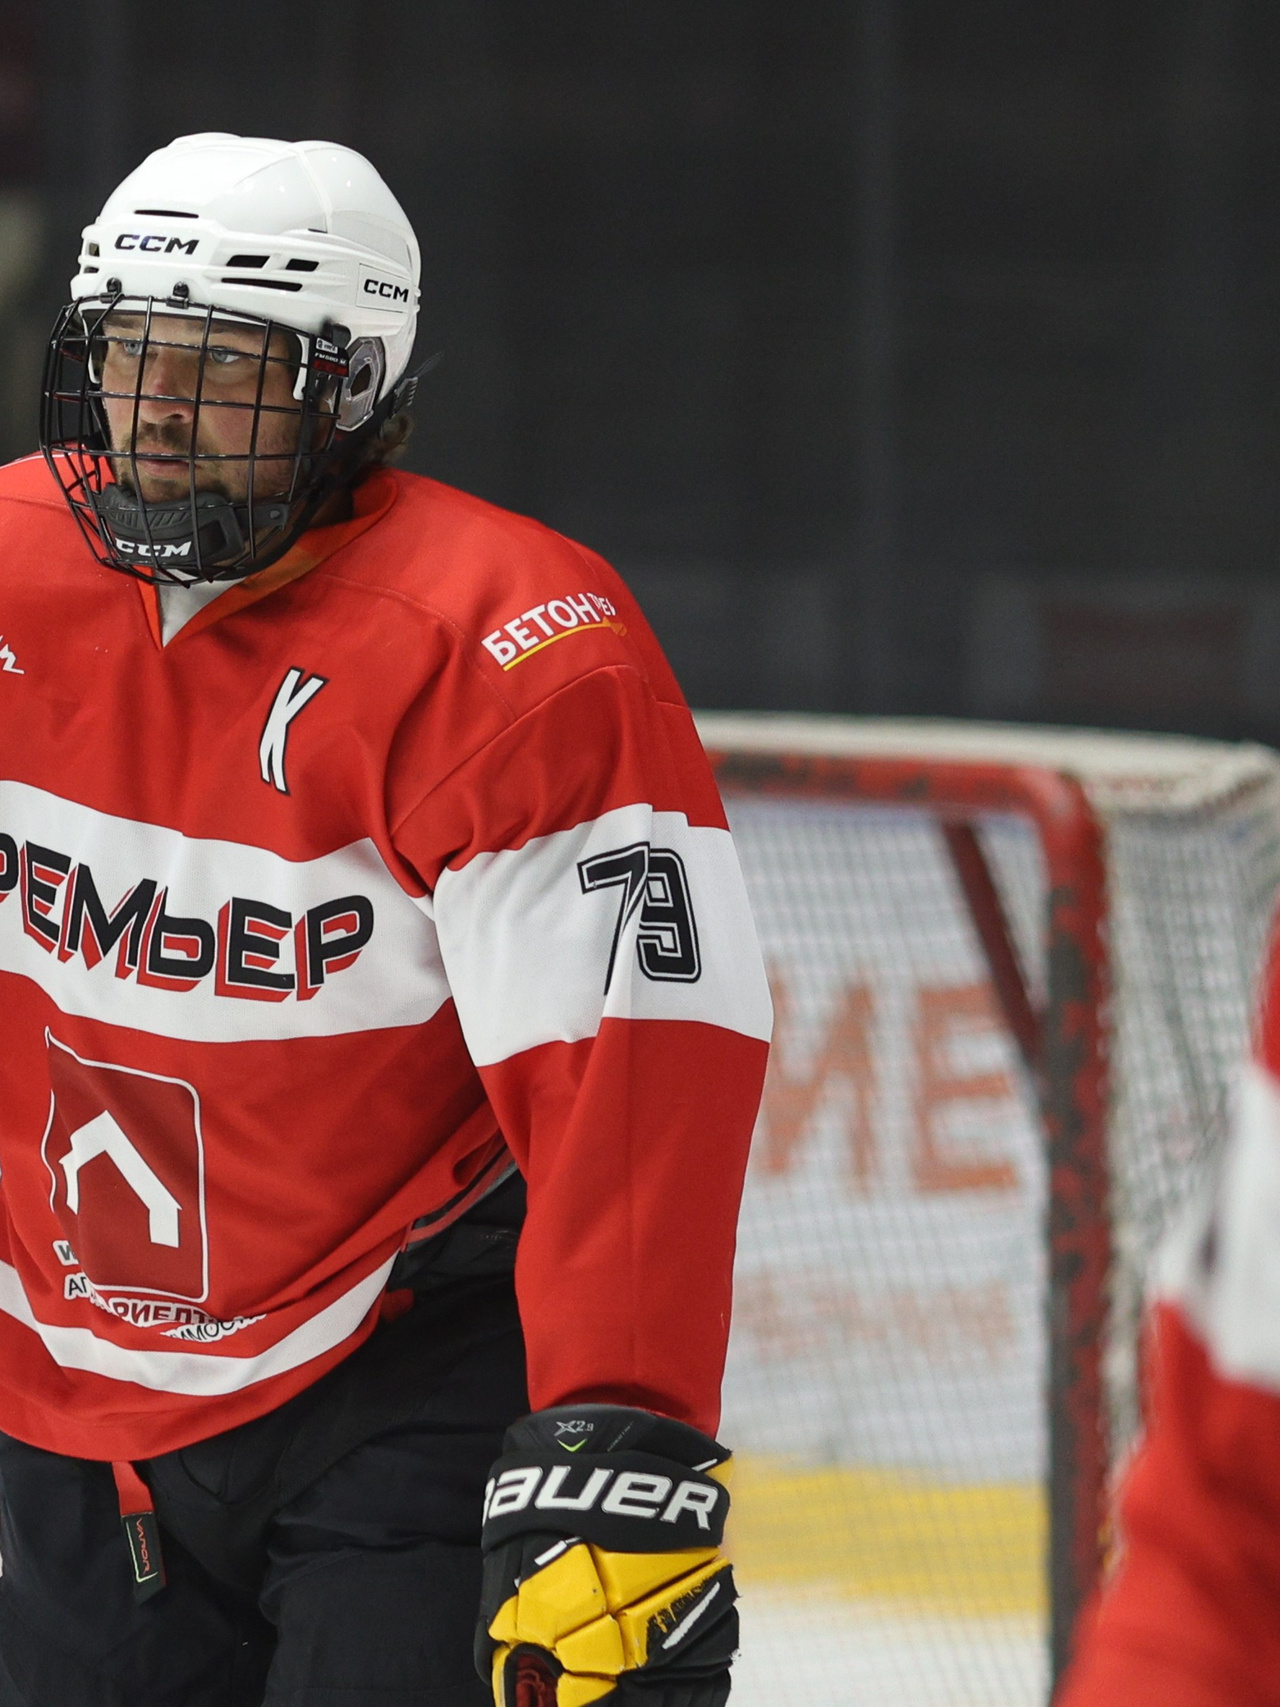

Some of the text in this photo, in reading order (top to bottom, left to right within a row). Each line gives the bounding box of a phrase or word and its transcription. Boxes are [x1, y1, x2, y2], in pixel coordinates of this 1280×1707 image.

[114, 234, 200, 256] CCM
[363, 278, 409, 304] CCM
[116, 538, 192, 558] CCM
[577, 841, 702, 996] 79
